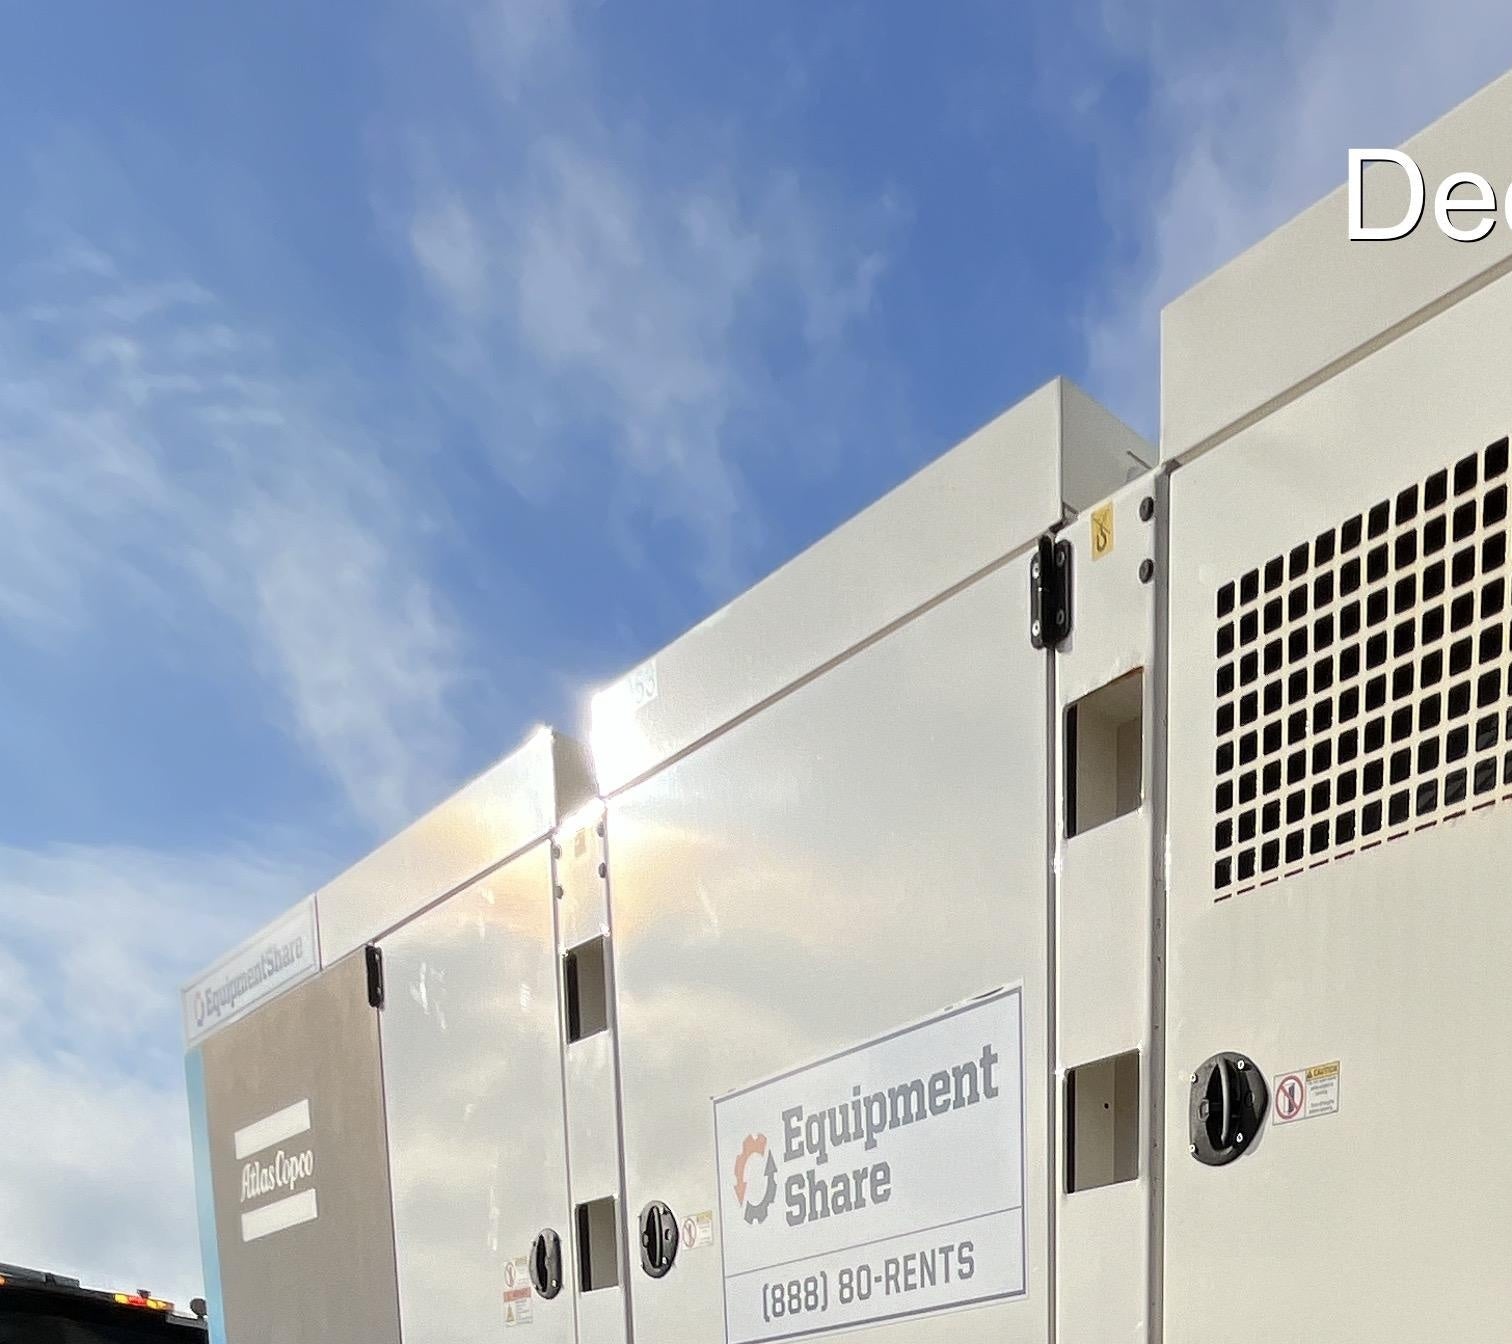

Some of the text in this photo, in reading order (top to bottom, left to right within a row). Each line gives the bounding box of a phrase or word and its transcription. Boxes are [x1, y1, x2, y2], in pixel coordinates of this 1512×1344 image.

[781, 1043, 999, 1166] Equipment
[785, 1160, 892, 1227] Share
[762, 1240, 976, 1323] (888) 80-RENTS
